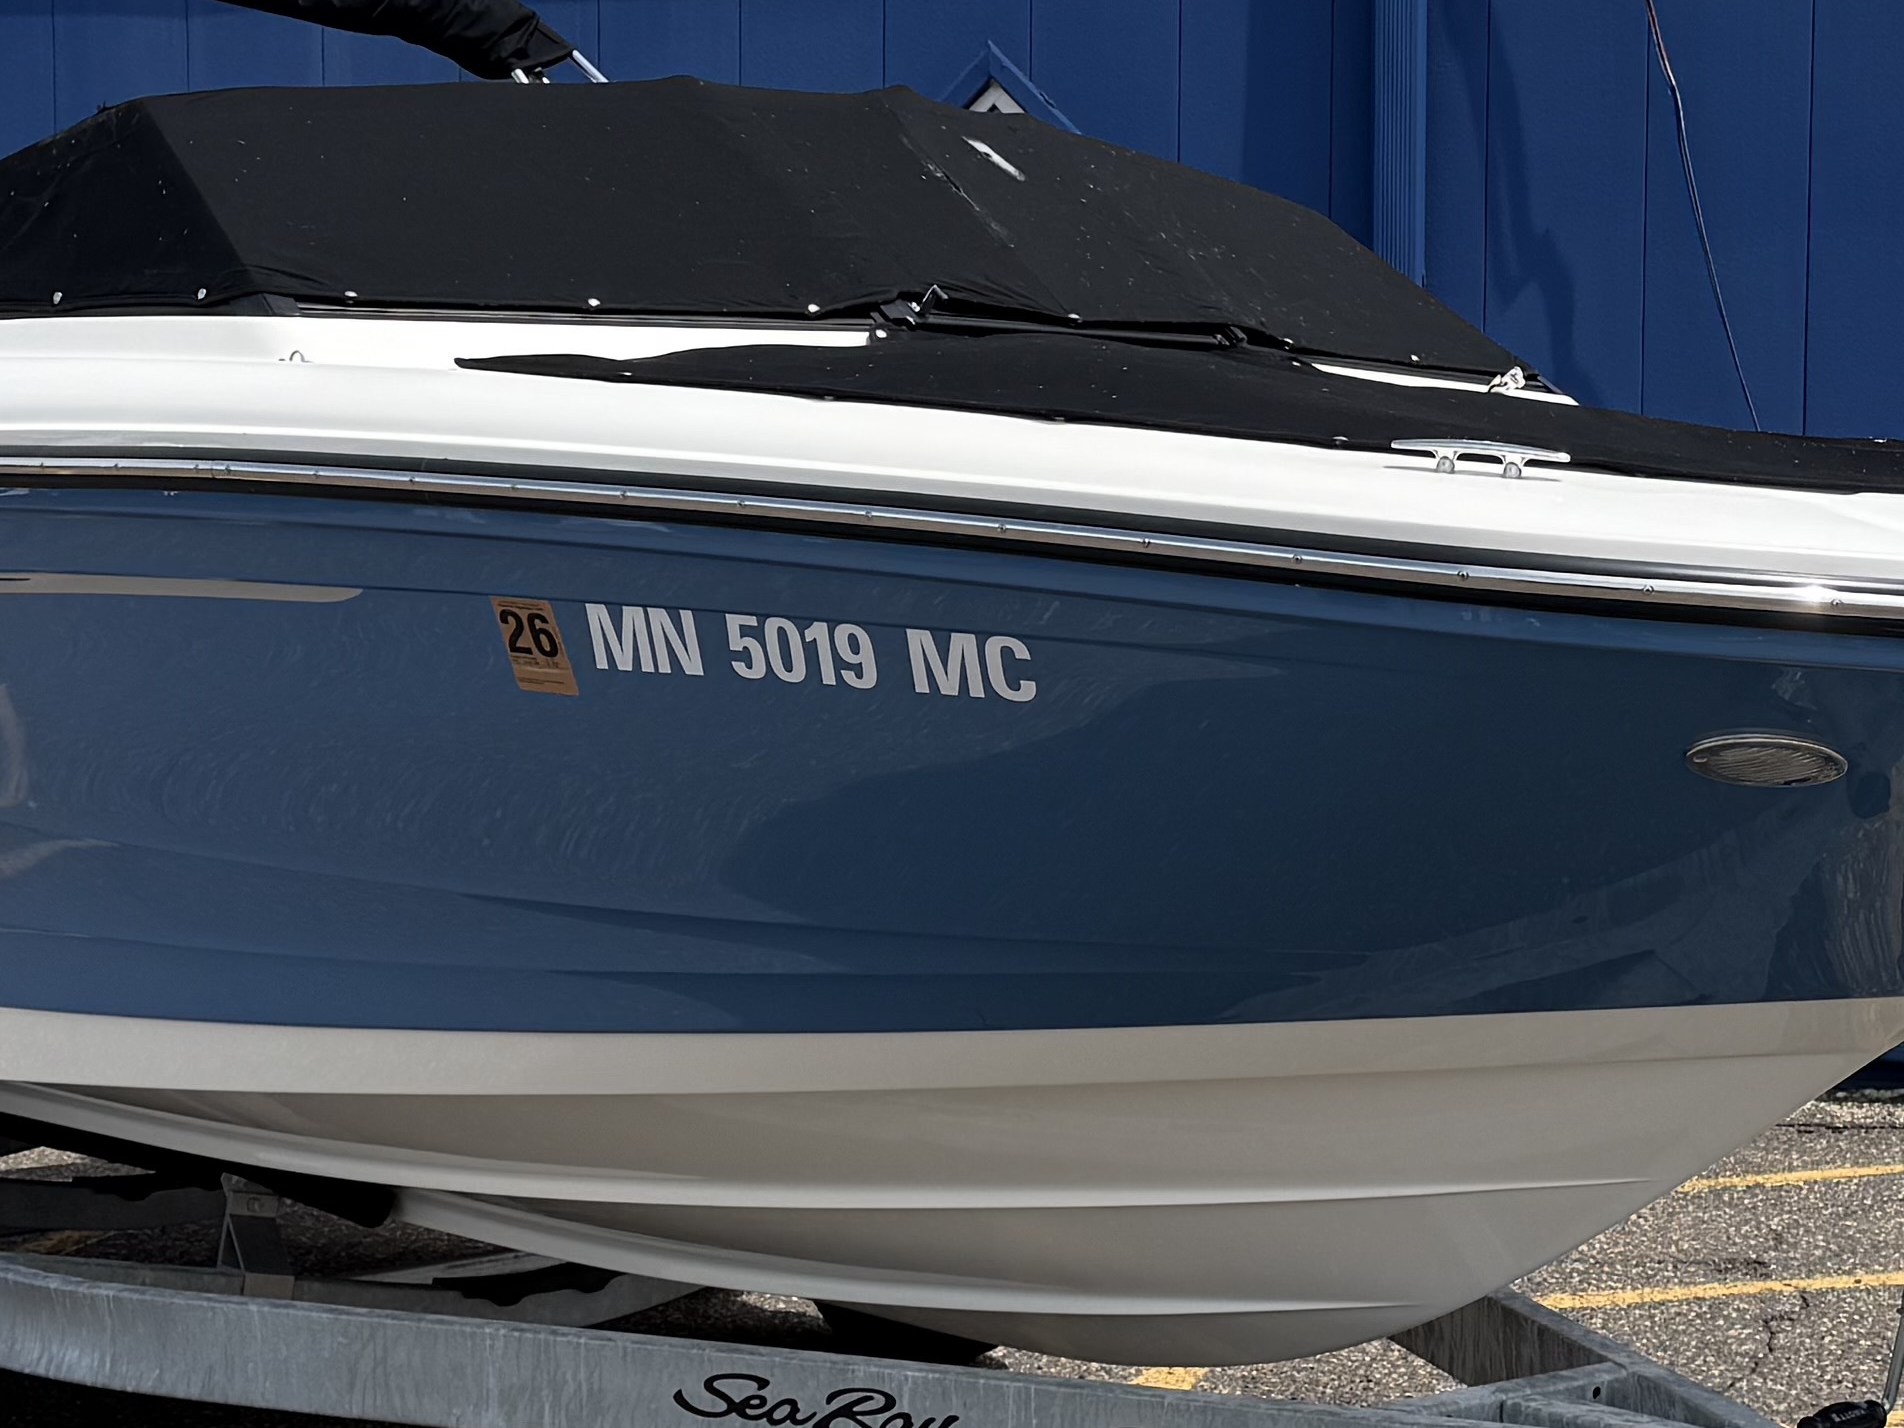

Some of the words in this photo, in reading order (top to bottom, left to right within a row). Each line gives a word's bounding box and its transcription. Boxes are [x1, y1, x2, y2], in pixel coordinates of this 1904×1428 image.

[499, 608, 559, 658] 26
[585, 602, 705, 676] MN
[725, 613, 878, 690] 5019
[907, 628, 1037, 702] MC
[672, 1372, 818, 1426] Sea
